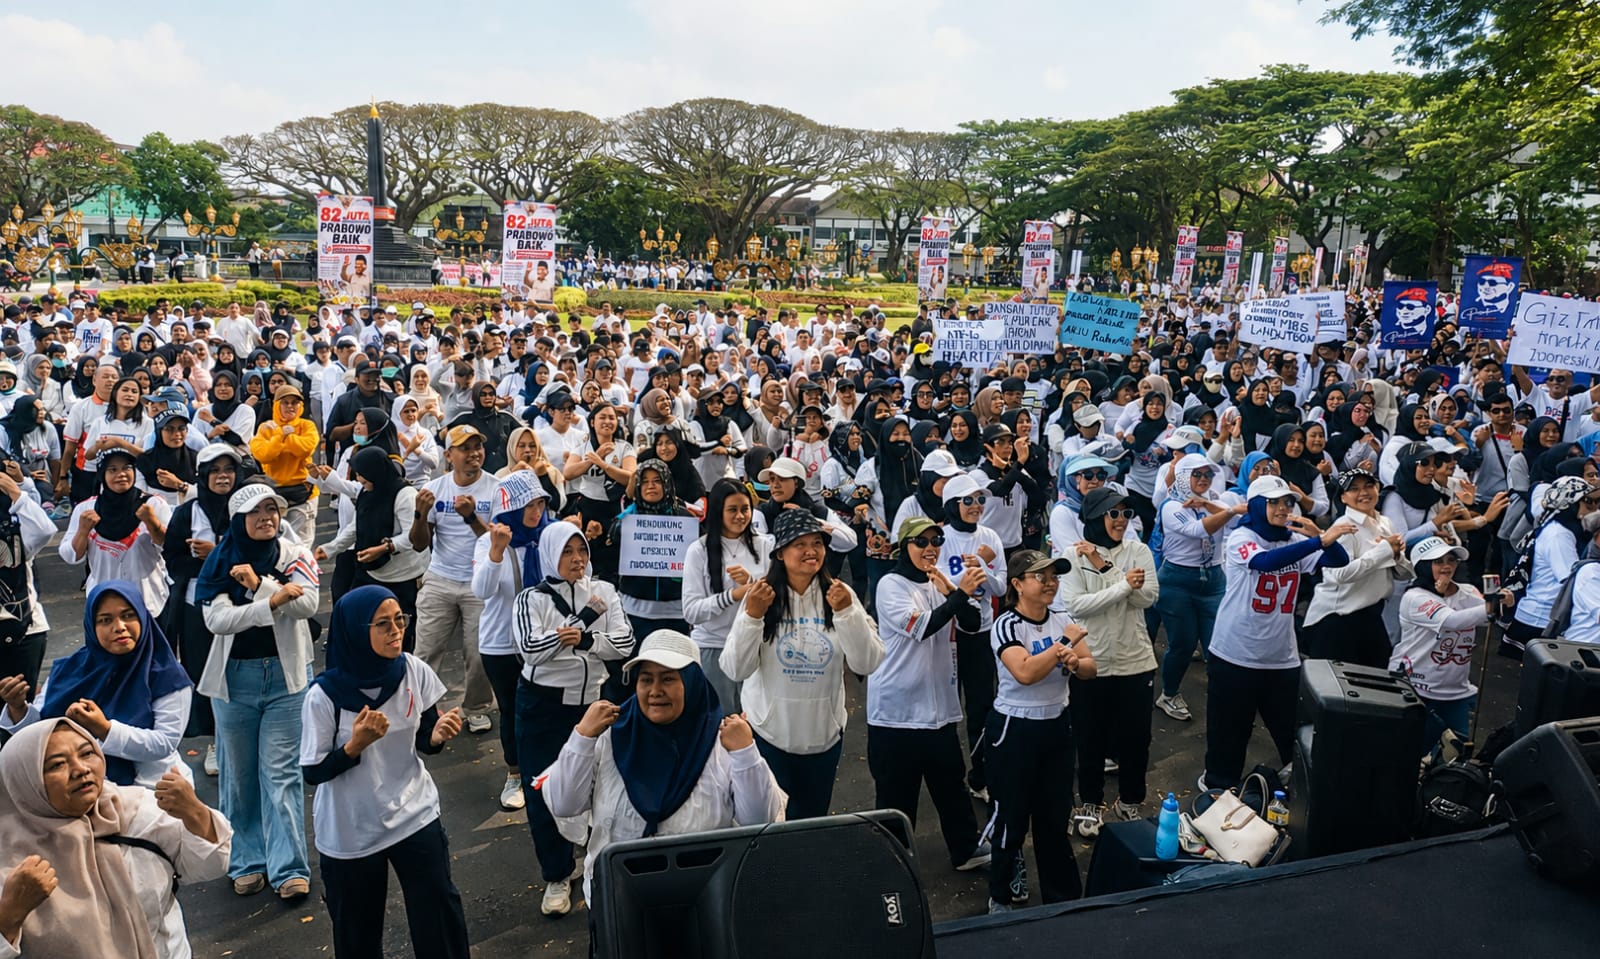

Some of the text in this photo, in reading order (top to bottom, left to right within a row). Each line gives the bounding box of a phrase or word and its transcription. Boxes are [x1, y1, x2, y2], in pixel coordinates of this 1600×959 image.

[320, 207, 370, 222] 82 JUTA
[506, 214, 526, 229] 82
[320, 222, 371, 234] PRABOWO
[332, 234, 361, 244] BAIK
[506, 230, 554, 240] PRABOWO
[517, 240, 544, 250] BAIK
[1252, 570, 1301, 614] 97
